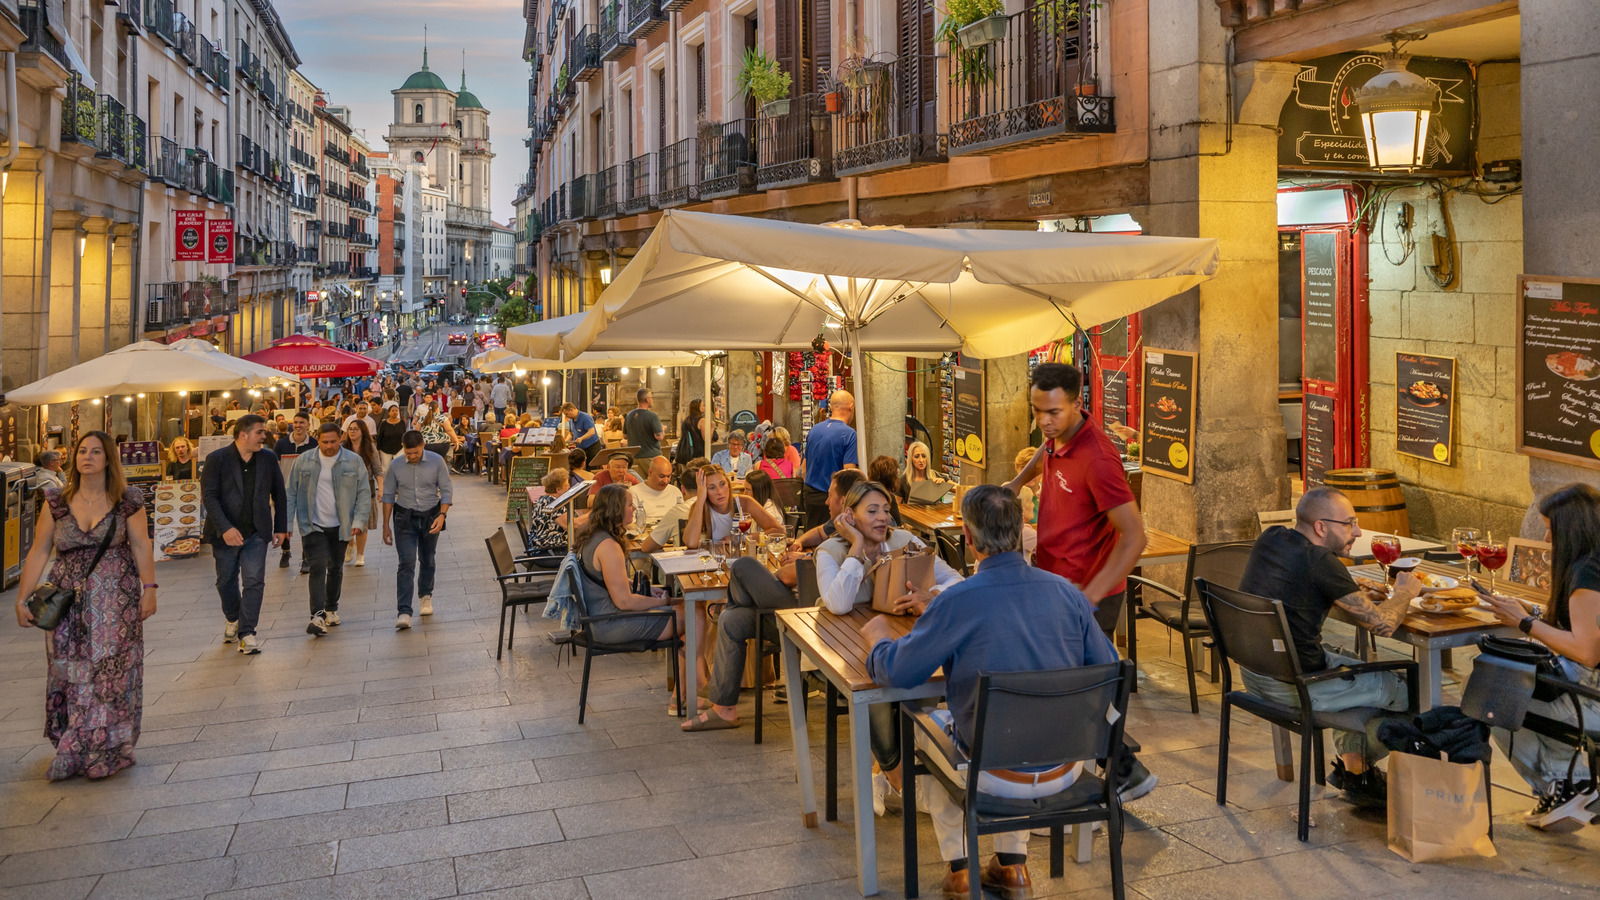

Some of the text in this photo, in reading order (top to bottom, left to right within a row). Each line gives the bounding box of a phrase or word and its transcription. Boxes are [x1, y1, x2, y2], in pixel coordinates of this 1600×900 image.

[1314, 139, 1366, 150] Especialida
[1308, 267, 1332, 276] PESCADOS
[1572, 302, 1598, 318] Tapas
